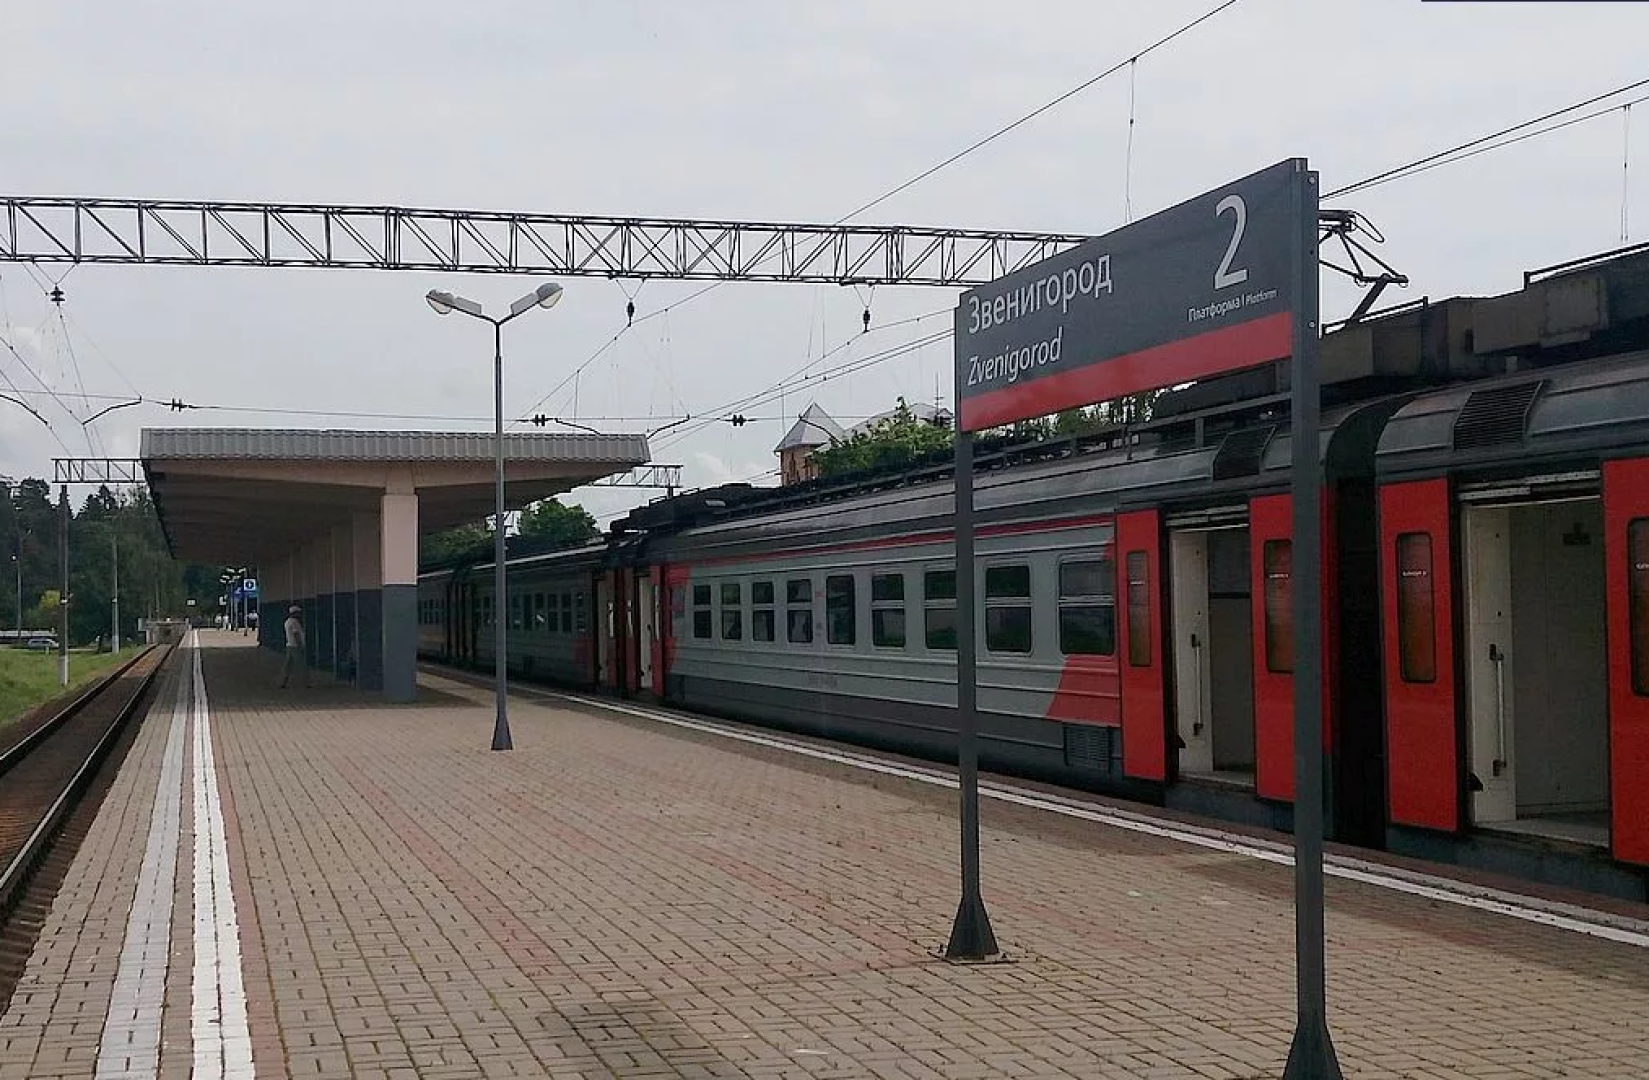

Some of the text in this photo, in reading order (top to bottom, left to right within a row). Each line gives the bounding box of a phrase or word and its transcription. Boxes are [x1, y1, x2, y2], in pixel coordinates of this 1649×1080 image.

[1214, 194, 1248, 290] 2
[968, 254, 1112, 334] Звенигород
[1188, 297, 1240, 323] Платформа
[967, 326, 1063, 386] Zvenigorod
